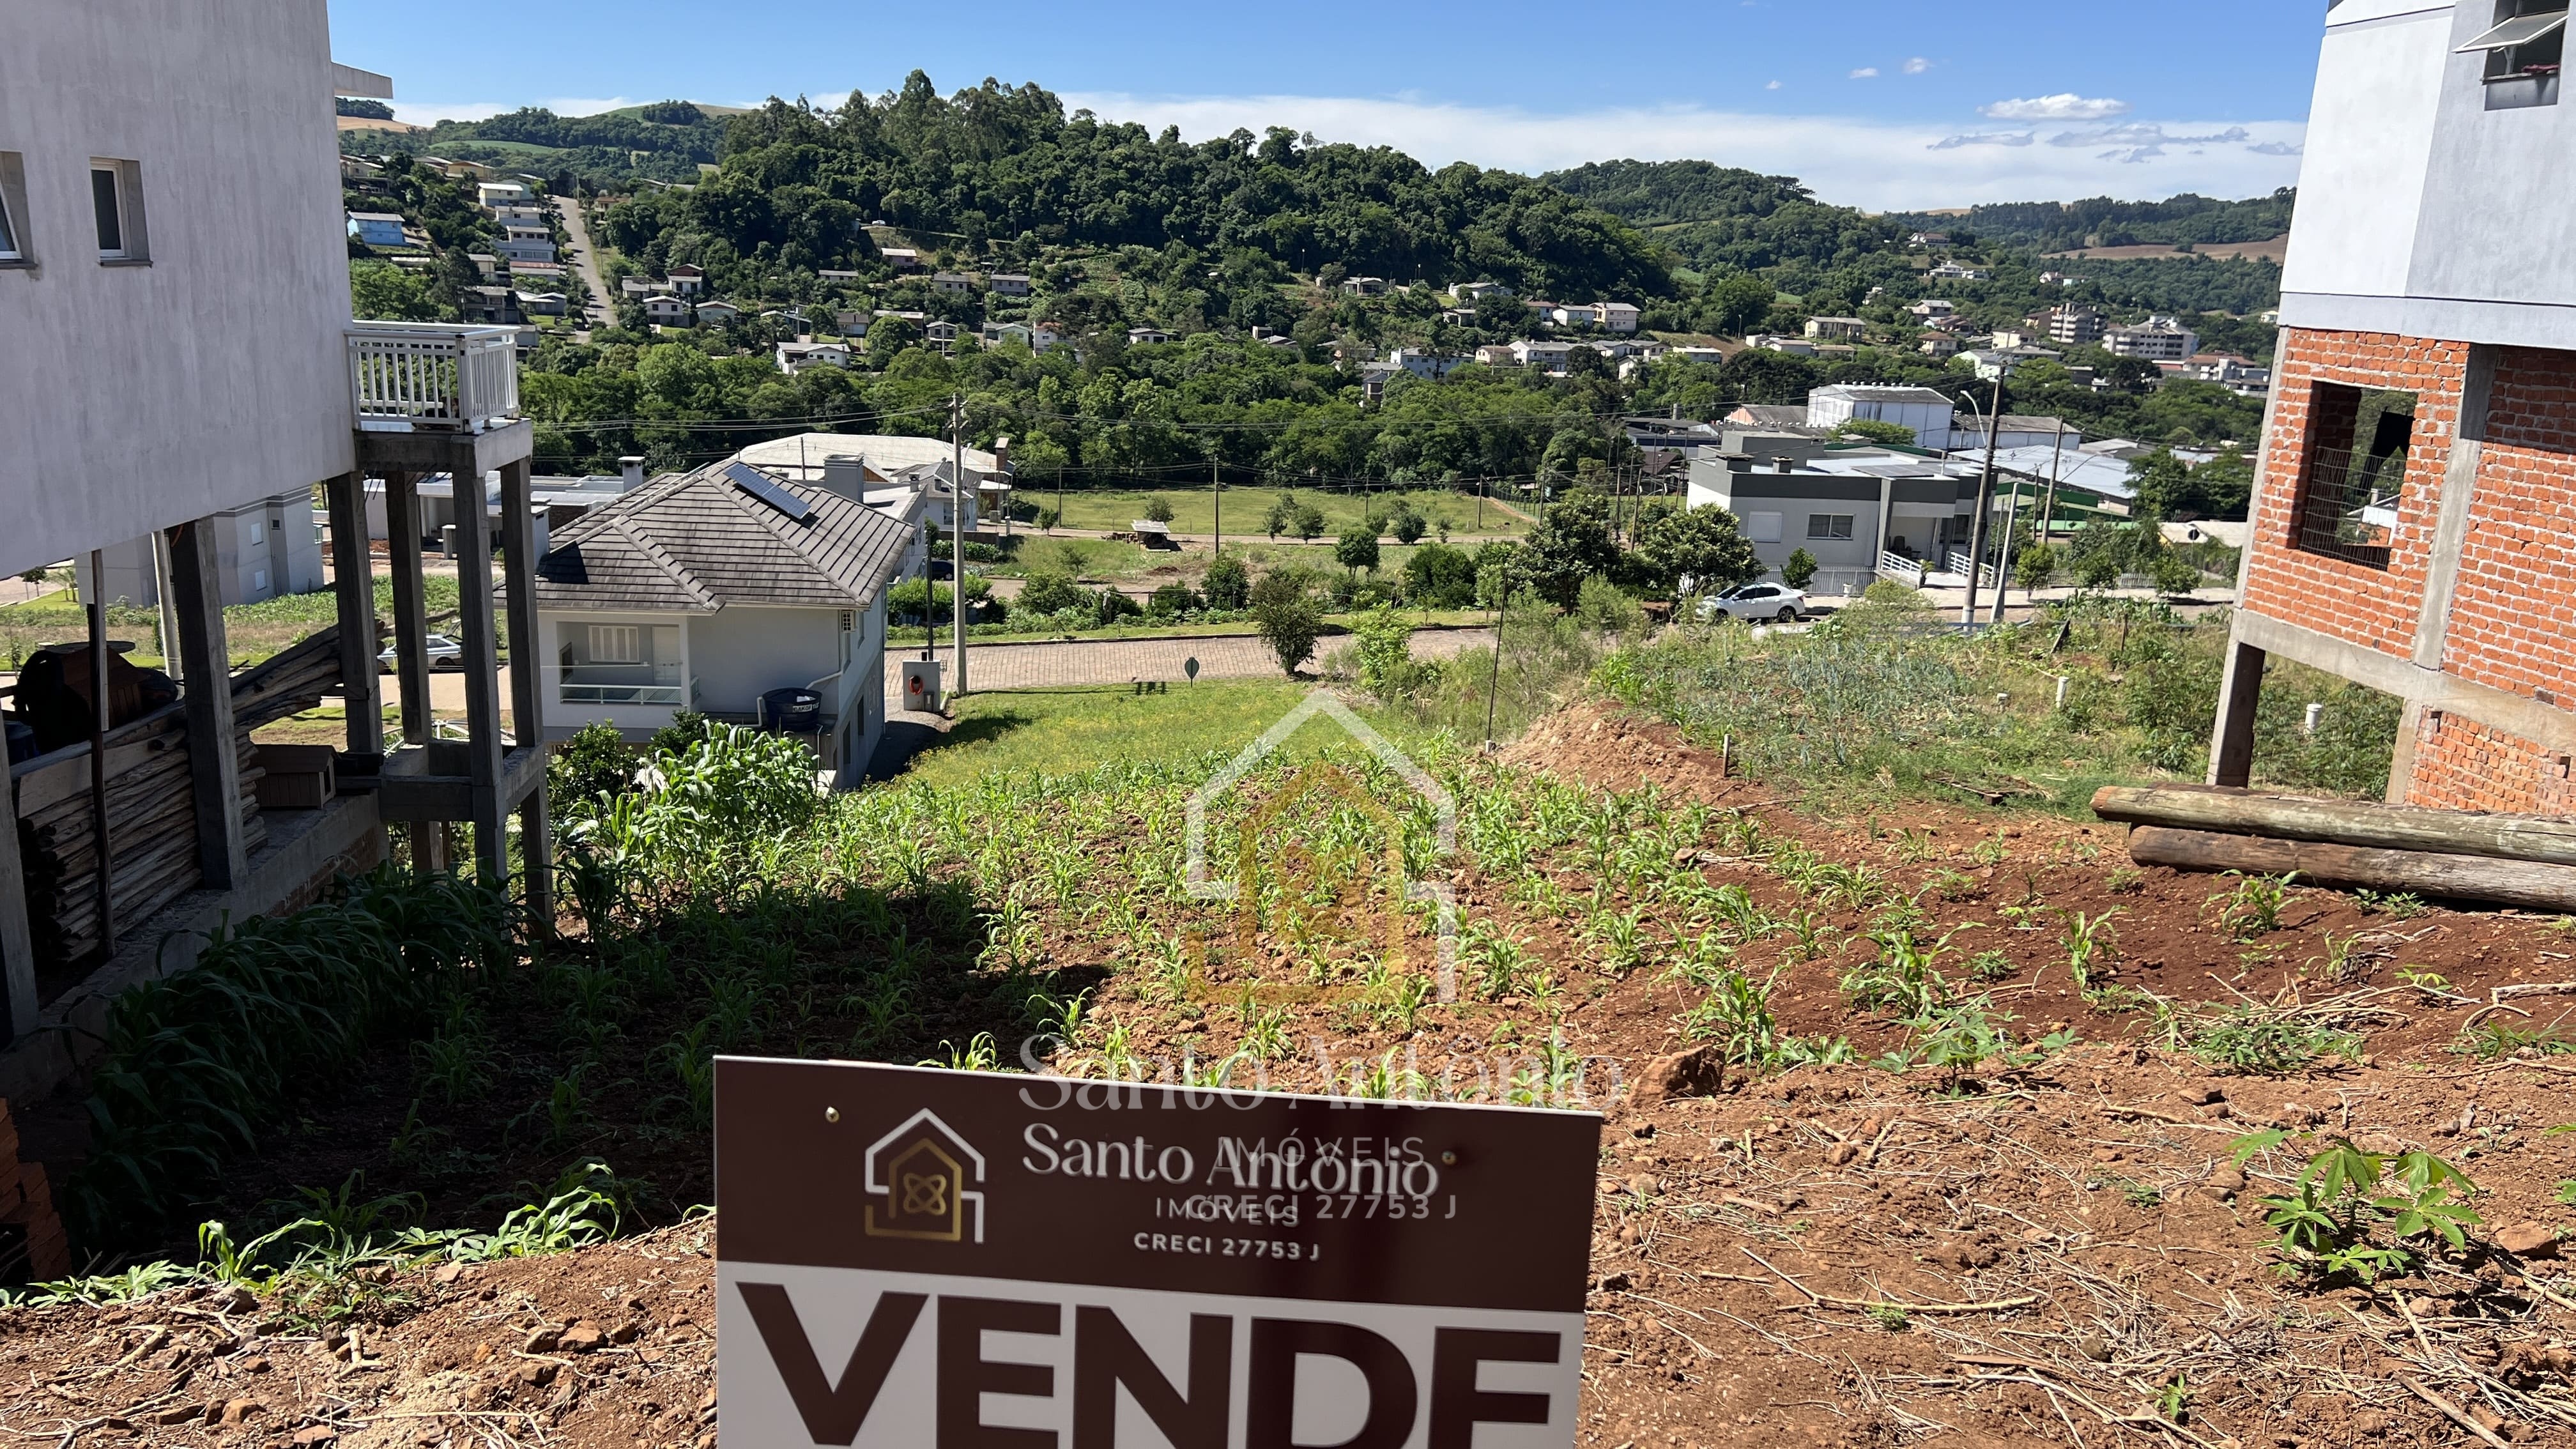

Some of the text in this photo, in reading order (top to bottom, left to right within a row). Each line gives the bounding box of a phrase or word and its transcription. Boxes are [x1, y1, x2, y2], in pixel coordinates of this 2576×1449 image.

[1022, 1123, 1438, 1197] Santo Antônio
[1156, 1196, 1300, 1227] IMÓVEIS
[1134, 1232, 1320, 1261] CRECI 27753 J
[735, 1281, 1561, 1449] VENDE
